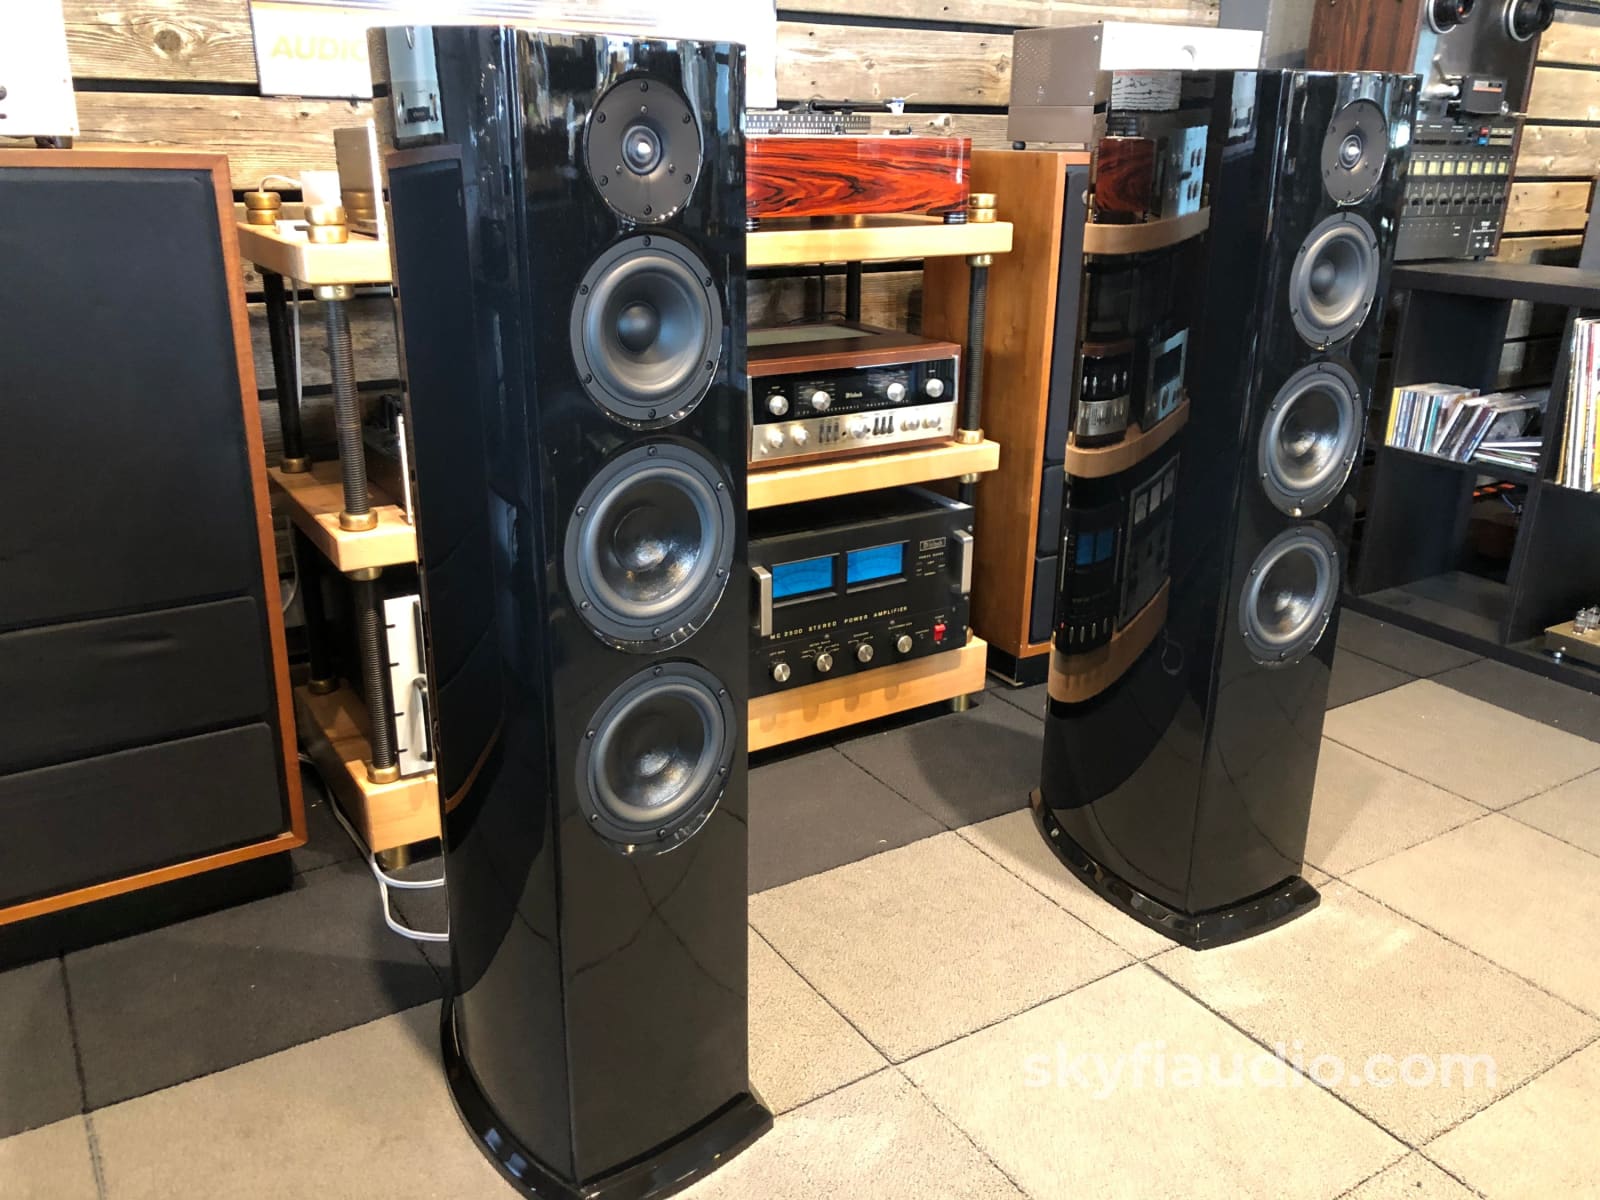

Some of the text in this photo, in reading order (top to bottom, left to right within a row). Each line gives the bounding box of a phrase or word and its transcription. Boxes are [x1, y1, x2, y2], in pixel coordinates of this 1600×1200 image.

[808, 621, 837, 632] STEREO
[844, 614, 868, 624] POWER
[873, 606, 908, 617] AMPLIFIER
